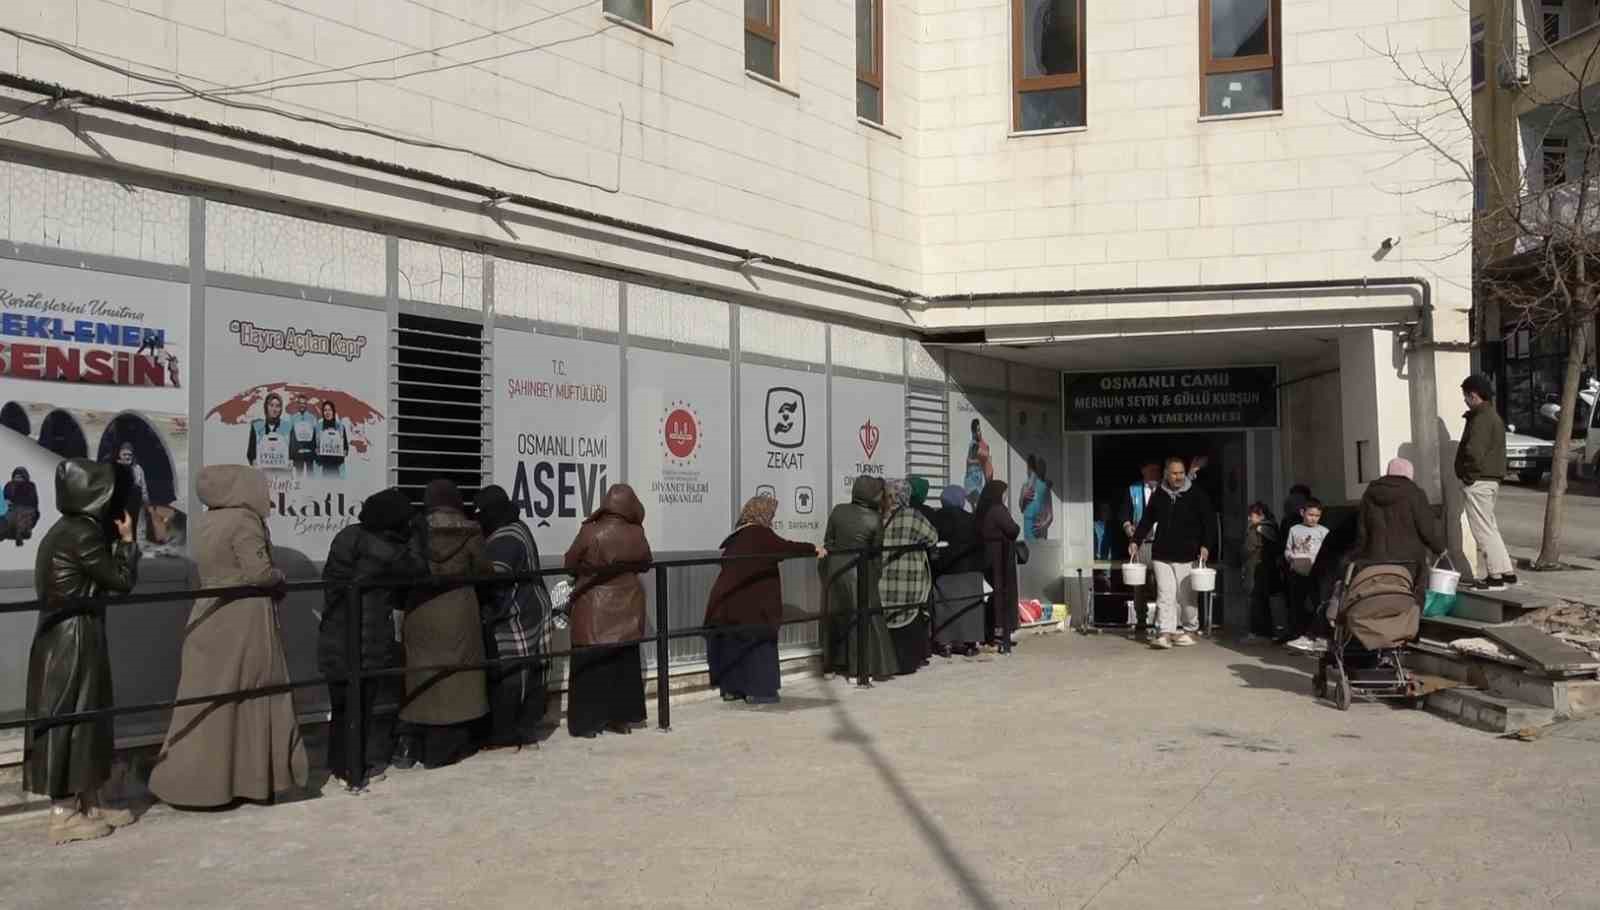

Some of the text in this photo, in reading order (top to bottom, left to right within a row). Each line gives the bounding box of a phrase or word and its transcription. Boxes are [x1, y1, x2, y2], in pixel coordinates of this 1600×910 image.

[88, 299, 144, 321] Unutma
[0, 312, 165, 349] EKLENEN
[1100, 375, 1176, 390] OSMANLI
[1074, 395, 1124, 409] MERHUM
[1161, 394, 1172, 406] &
[1095, 415, 1111, 427] AŞ
[1137, 413, 1148, 424] &
[518, 433, 607, 459] OSMANLI CAMİ
[767, 451, 804, 470] ZEKAT
